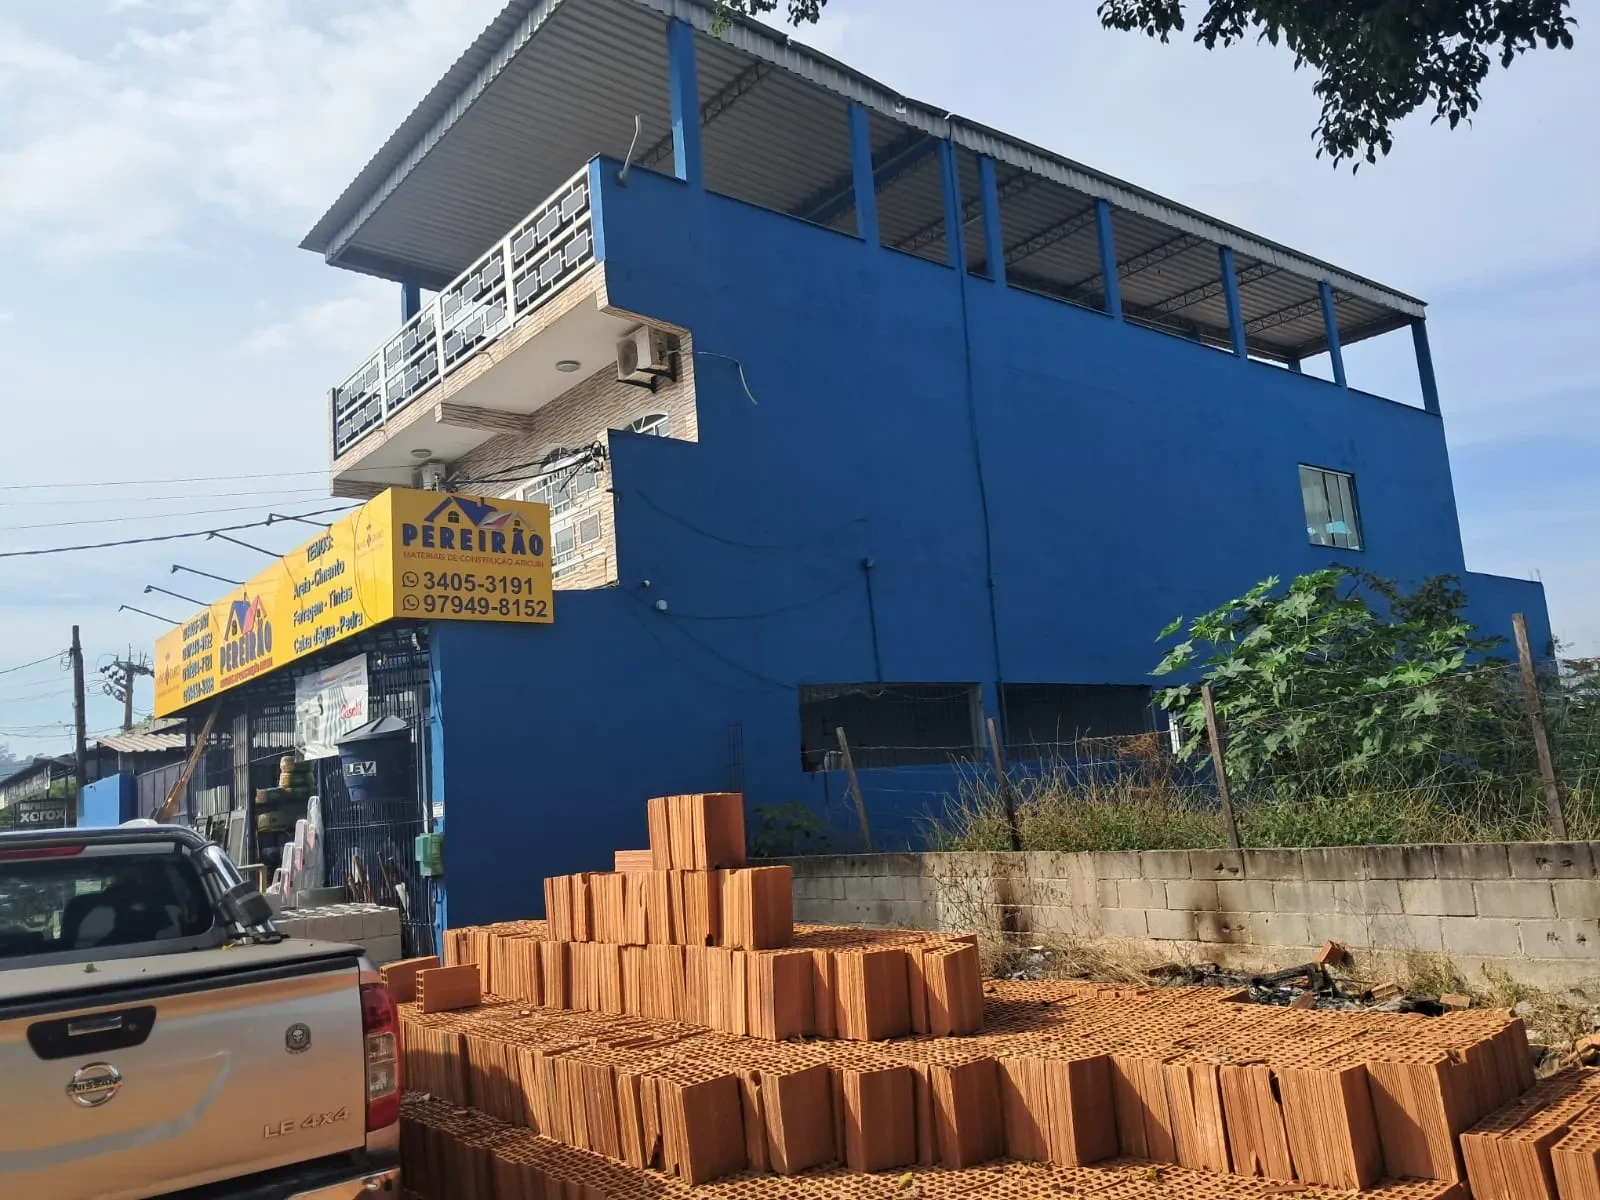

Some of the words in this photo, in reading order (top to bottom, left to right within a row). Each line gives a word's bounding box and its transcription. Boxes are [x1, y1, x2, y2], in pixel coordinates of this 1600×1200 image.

[306, 534, 334, 563] TEMOS:
[402, 523, 544, 557] PEREIRÃO
[403, 551, 446, 561] MATERIAIS
[447, 553, 459, 562] DE
[314, 558, 345, 587] Cimento
[423, 571, 533, 595] 3405-3191
[328, 587, 353, 609] Tintas
[423, 594, 549, 618] 97949-8152
[294, 634, 312, 654] Caixa
[340, 611, 363, 634] Pedra
[220, 617, 272, 675] PEREIRÃO
[74, 1079, 117, 1092] NISSAN
[263, 1119, 295, 1139] LE
